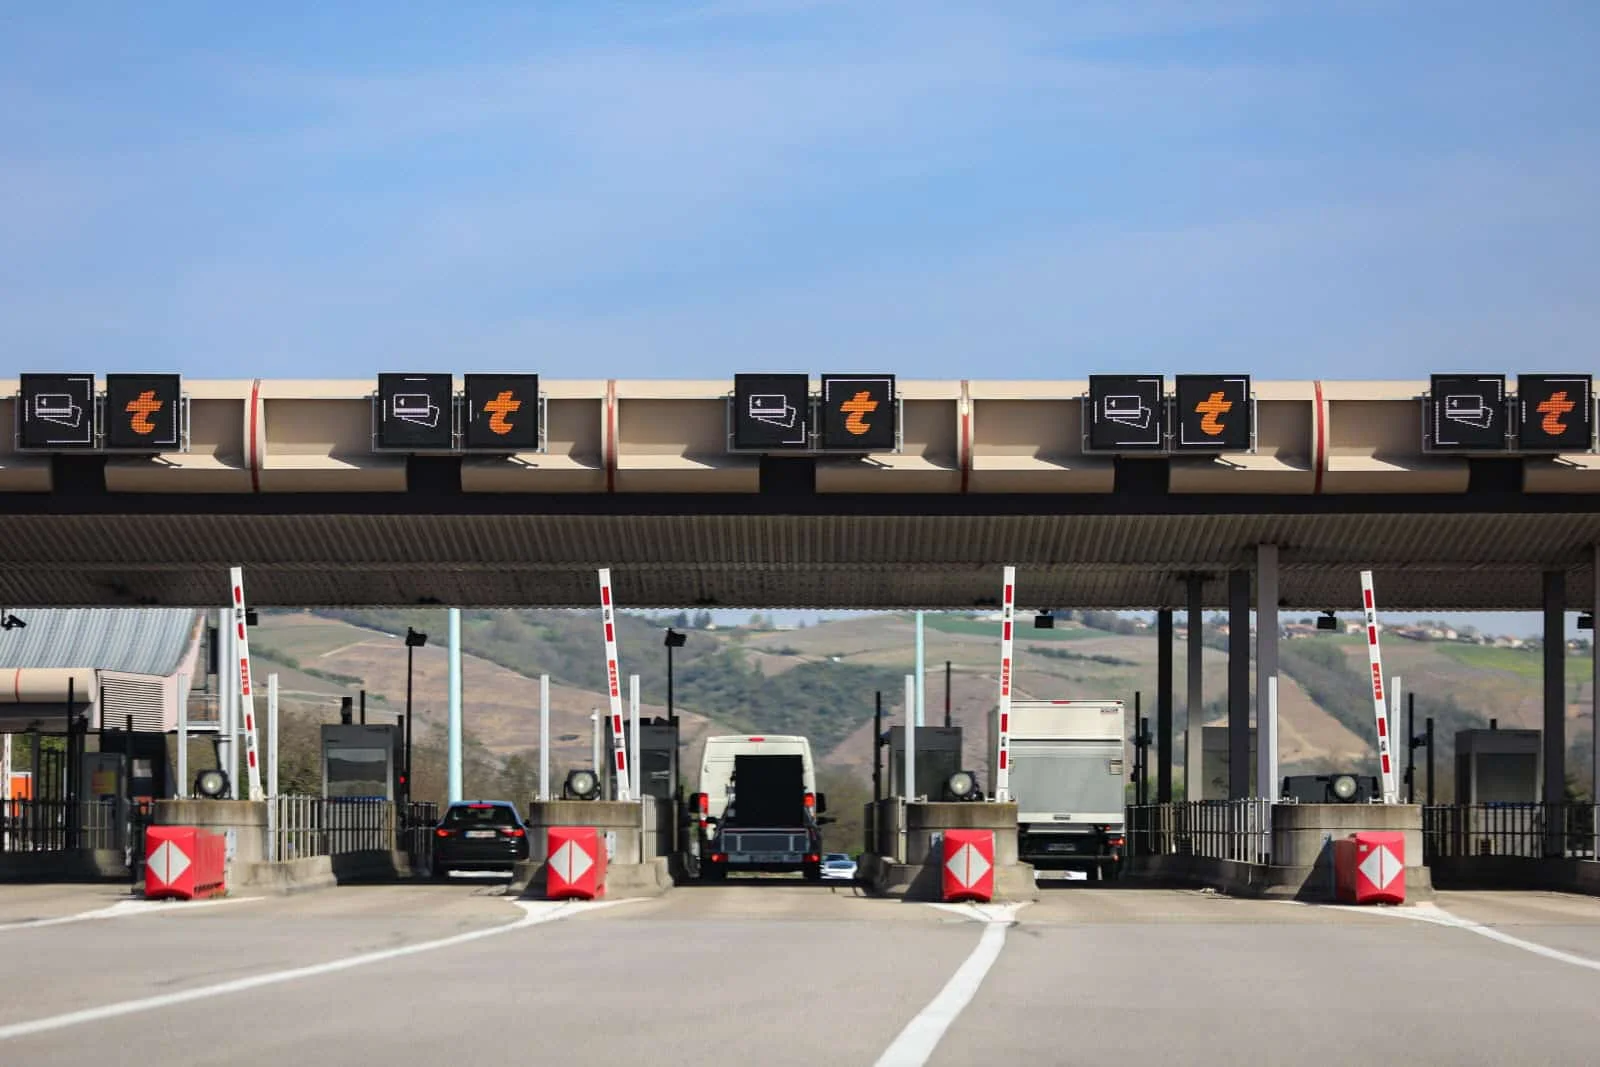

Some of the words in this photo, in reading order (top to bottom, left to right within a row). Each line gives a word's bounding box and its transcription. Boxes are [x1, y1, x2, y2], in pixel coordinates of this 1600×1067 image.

[126, 390, 163, 435] t
[484, 390, 523, 435] t
[840, 391, 879, 435] t
[1195, 392, 1233, 436] t
[1536, 392, 1576, 436] t
